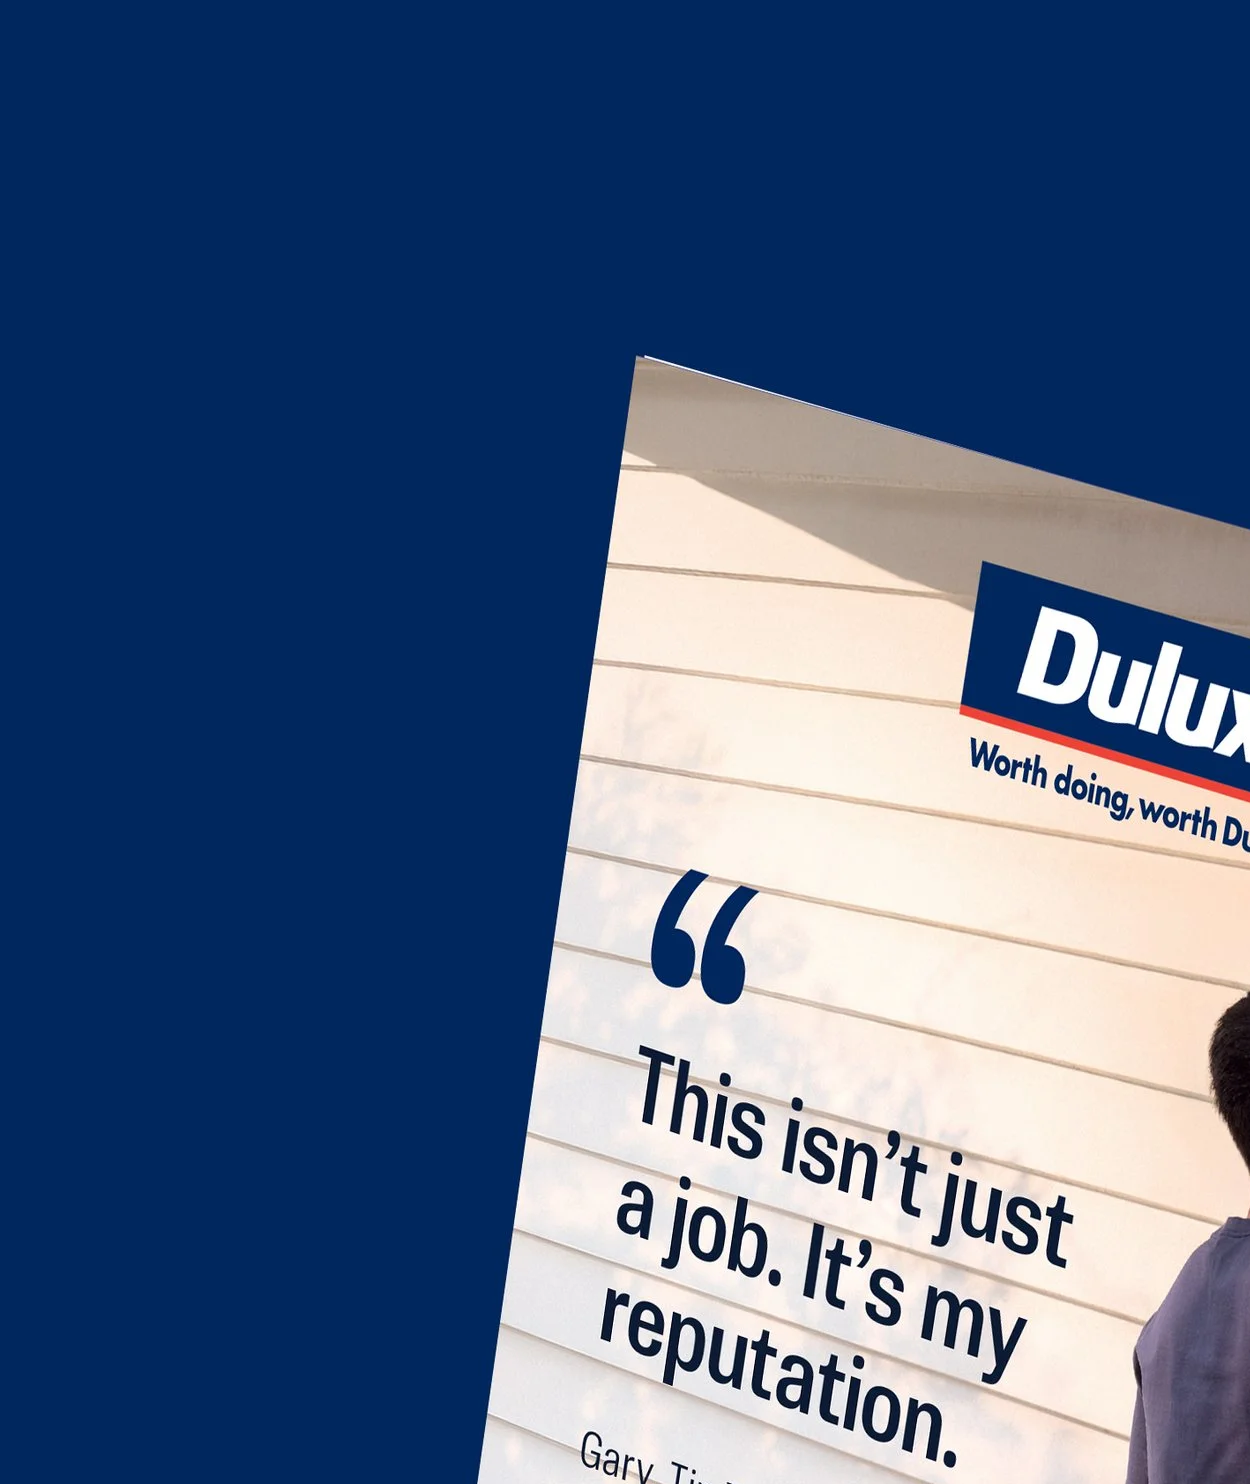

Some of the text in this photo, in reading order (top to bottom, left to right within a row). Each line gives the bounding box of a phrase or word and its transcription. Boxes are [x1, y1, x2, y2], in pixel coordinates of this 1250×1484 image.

[970, 737, 1047, 789] Worth
[1054, 764, 1134, 822] doing,
[1138, 797, 1217, 841] worth
[638, 1045, 1074, 1268] This isn’t just
[600, 1287, 958, 1468] reputation.
[616, 1176, 1028, 1385] a job. It’s my
